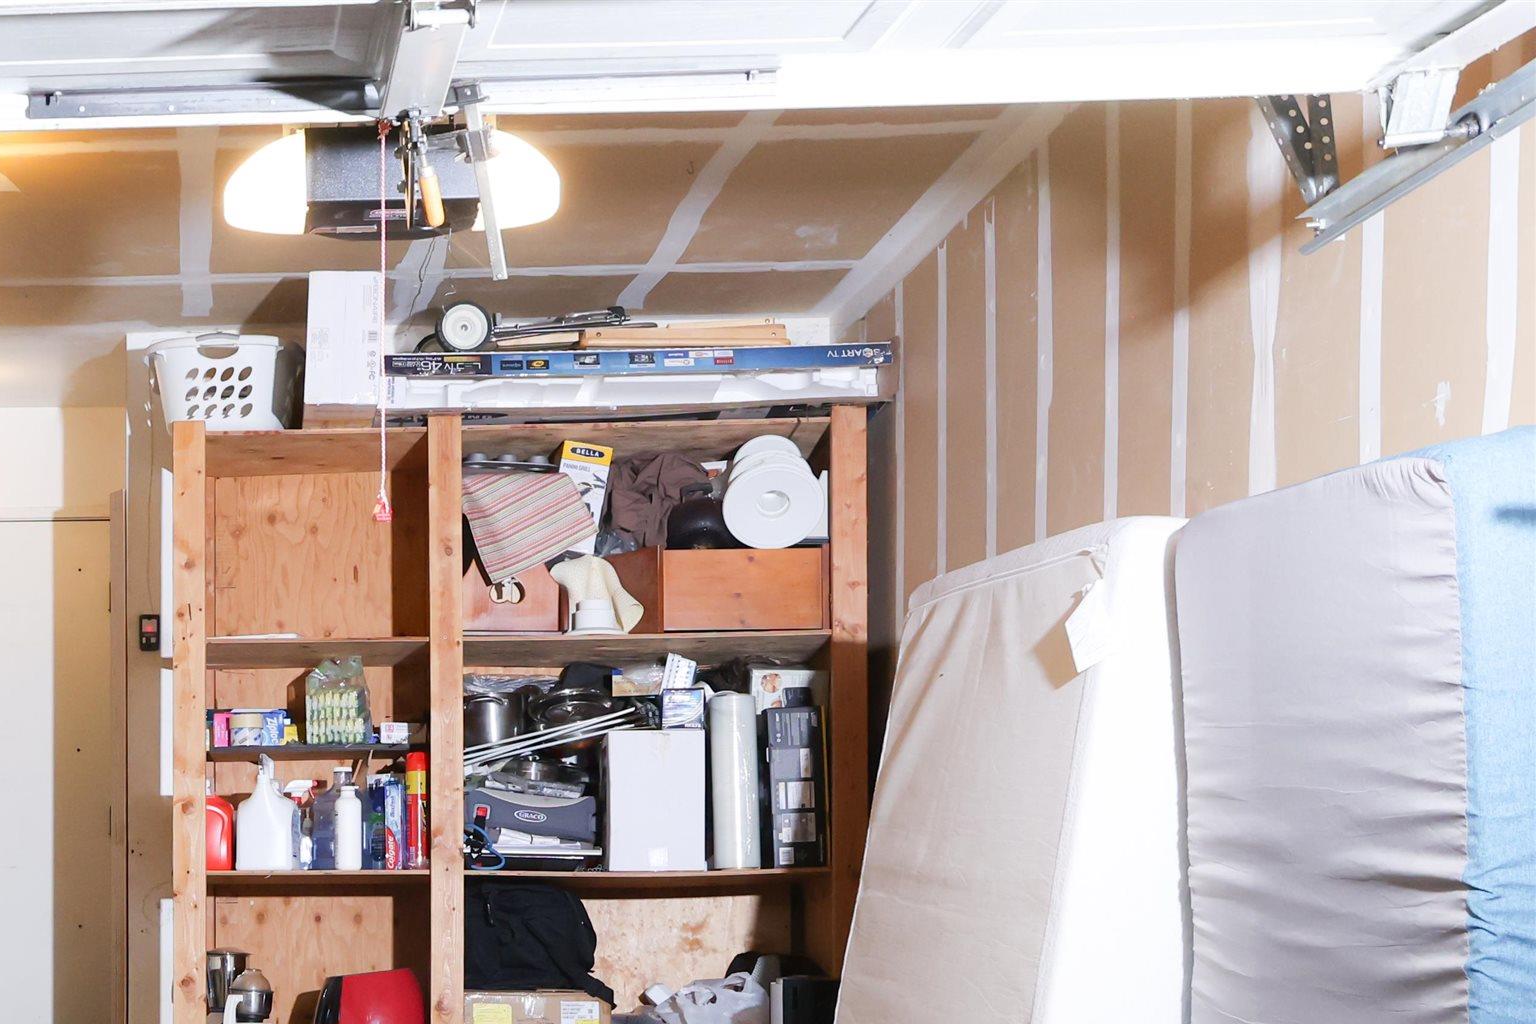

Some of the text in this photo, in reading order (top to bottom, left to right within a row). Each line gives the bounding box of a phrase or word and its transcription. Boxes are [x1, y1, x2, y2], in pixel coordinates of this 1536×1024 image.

[576, 448, 600, 457] BELLA
[266, 716, 279, 746] Ziploc
[518, 811, 544, 820] GRACO
[386, 835, 396, 869] Colgate
